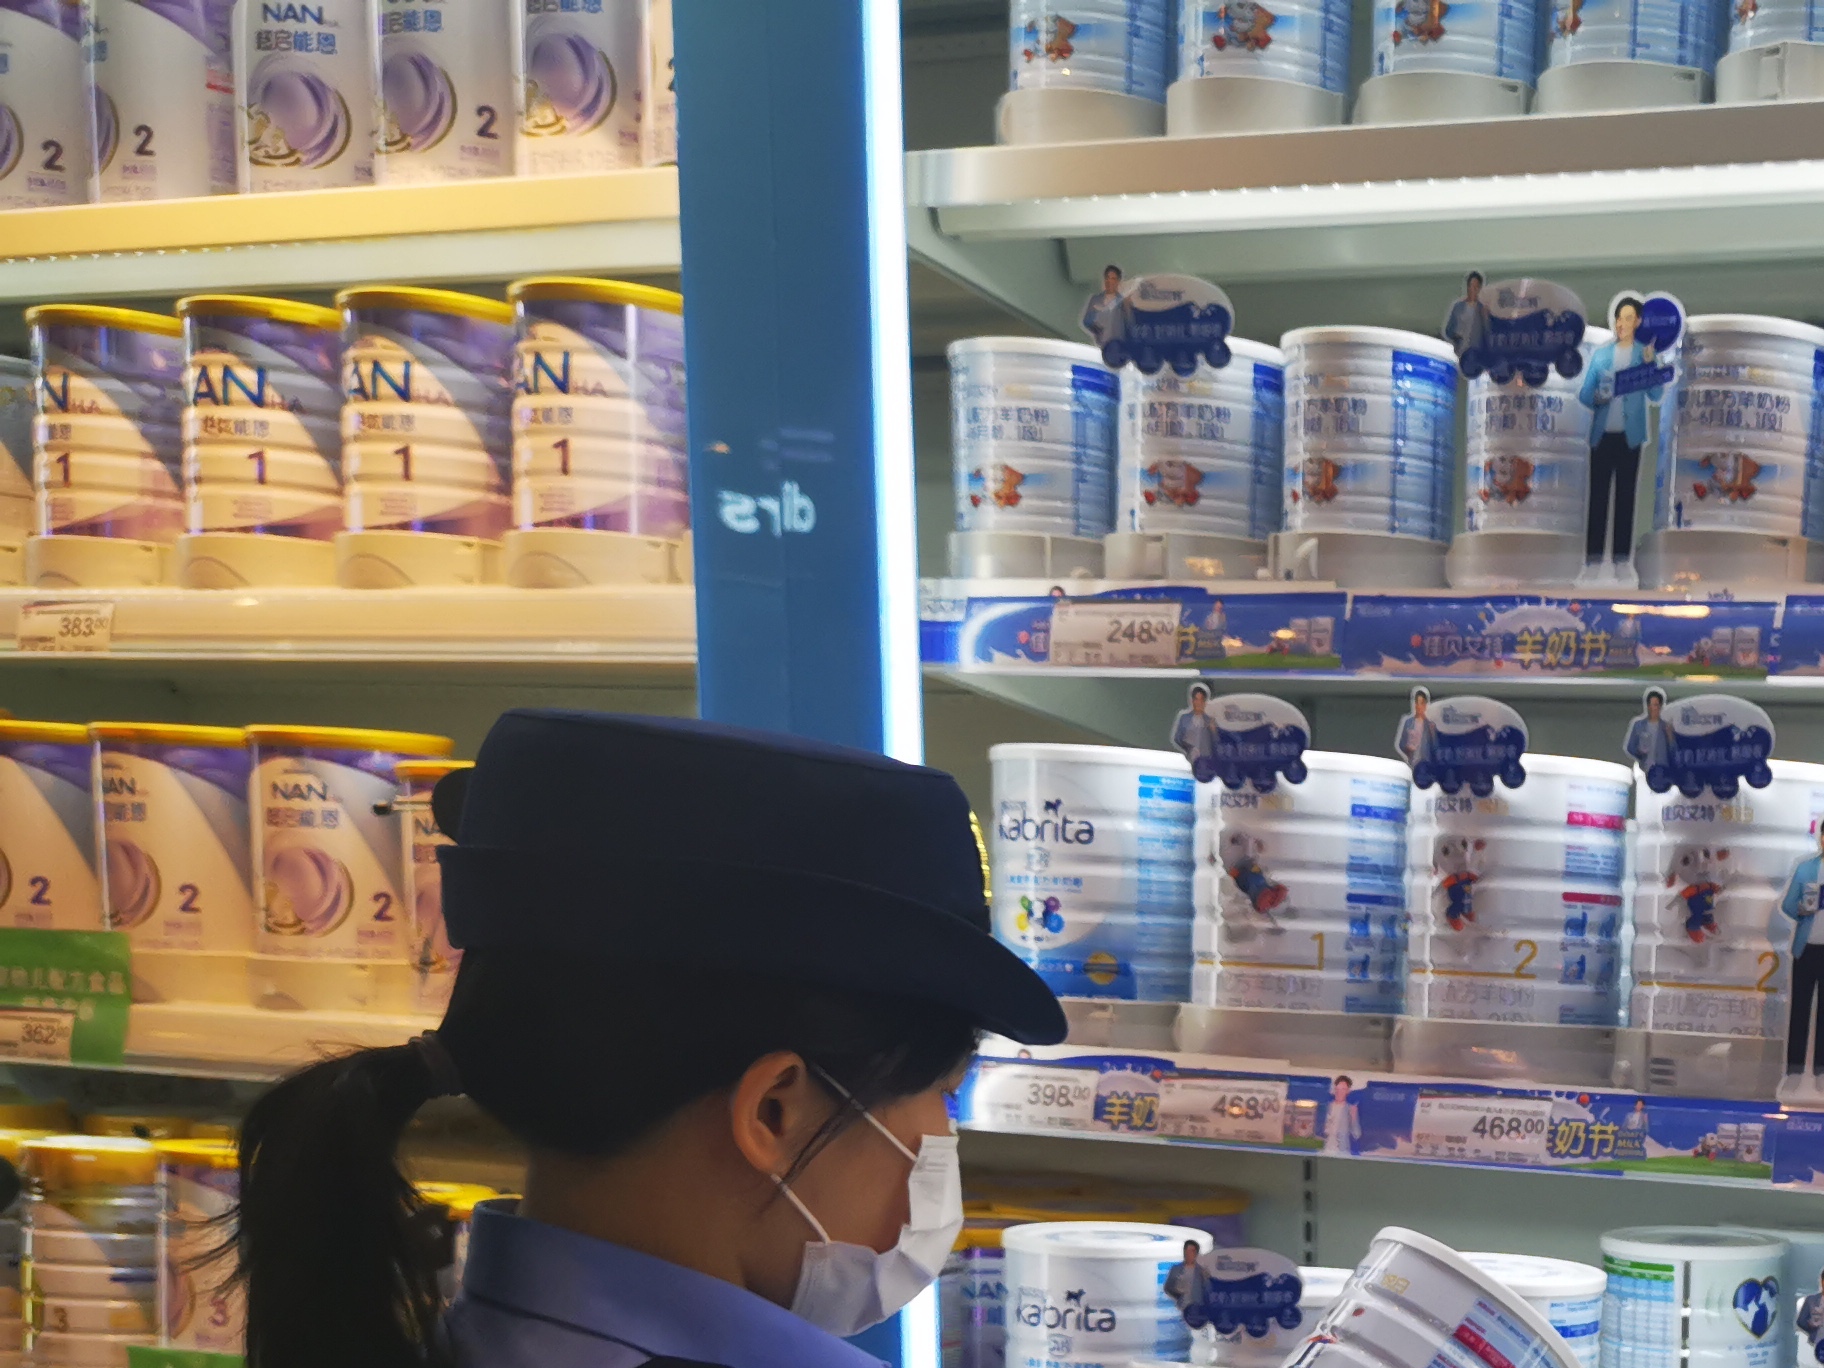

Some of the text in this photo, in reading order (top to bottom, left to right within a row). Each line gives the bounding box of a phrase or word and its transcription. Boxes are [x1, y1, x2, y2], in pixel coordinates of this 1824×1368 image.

[261, 2, 325, 25] NAN
[476, 105, 498, 139] 2
[40, 140, 65, 172] 2
[134, 125, 155, 157] 2
[56, 451, 71, 487] 1
[247, 451, 267, 485] 1
[393, 445, 413, 481] 1
[552, 437, 570, 476] 1
[1514, 628, 1611, 666] 羊奶节
[271, 781, 329, 803] NAN
[1000, 814, 1095, 846] kabrita
[30, 876, 52, 906] 2
[179, 884, 201, 914] 2
[373, 893, 394, 923] 2
[1513, 939, 1538, 979] 2
[1756, 951, 1781, 993] 2
[1027, 1083, 1091, 1108] 398.00
[1472, 1115, 1546, 1142] 468.00
